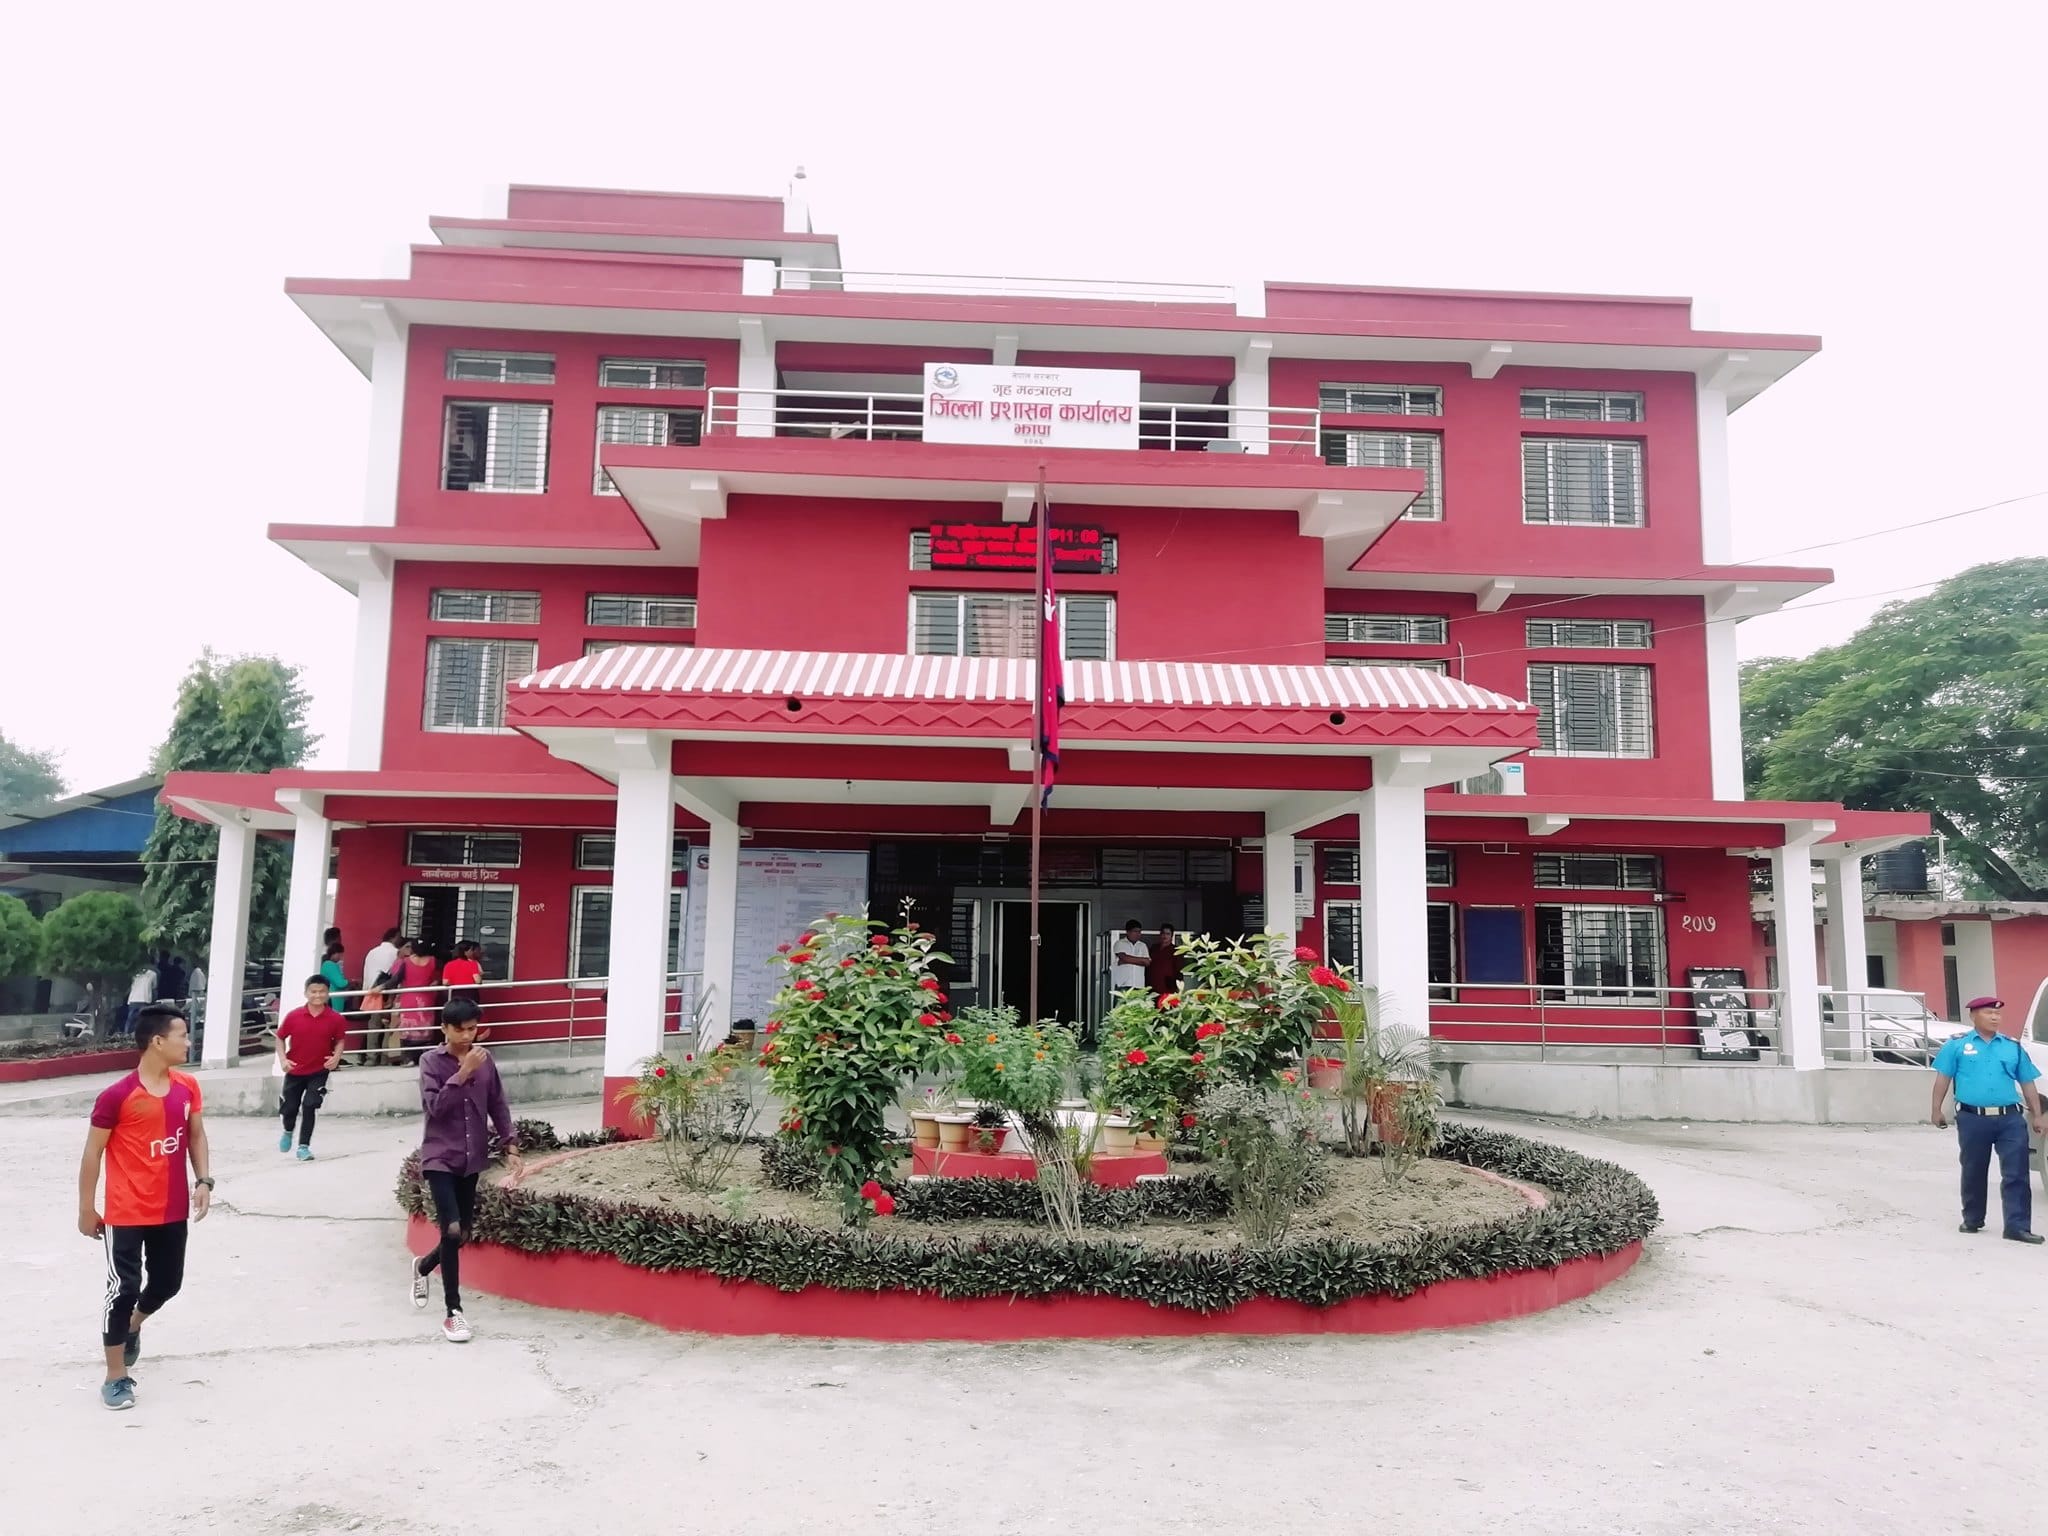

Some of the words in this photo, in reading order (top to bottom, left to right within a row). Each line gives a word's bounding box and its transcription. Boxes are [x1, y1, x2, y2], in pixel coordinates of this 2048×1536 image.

[992, 384, 1012, 397] गृह
[1016, 385, 1073, 397] मन्त्रालय
[930, 393, 984, 418] जिल्ला
[990, 401, 1053, 421] प्रशासन
[1059, 399, 1133, 424] कार्यालय
[149, 1126, 184, 1159] nef
